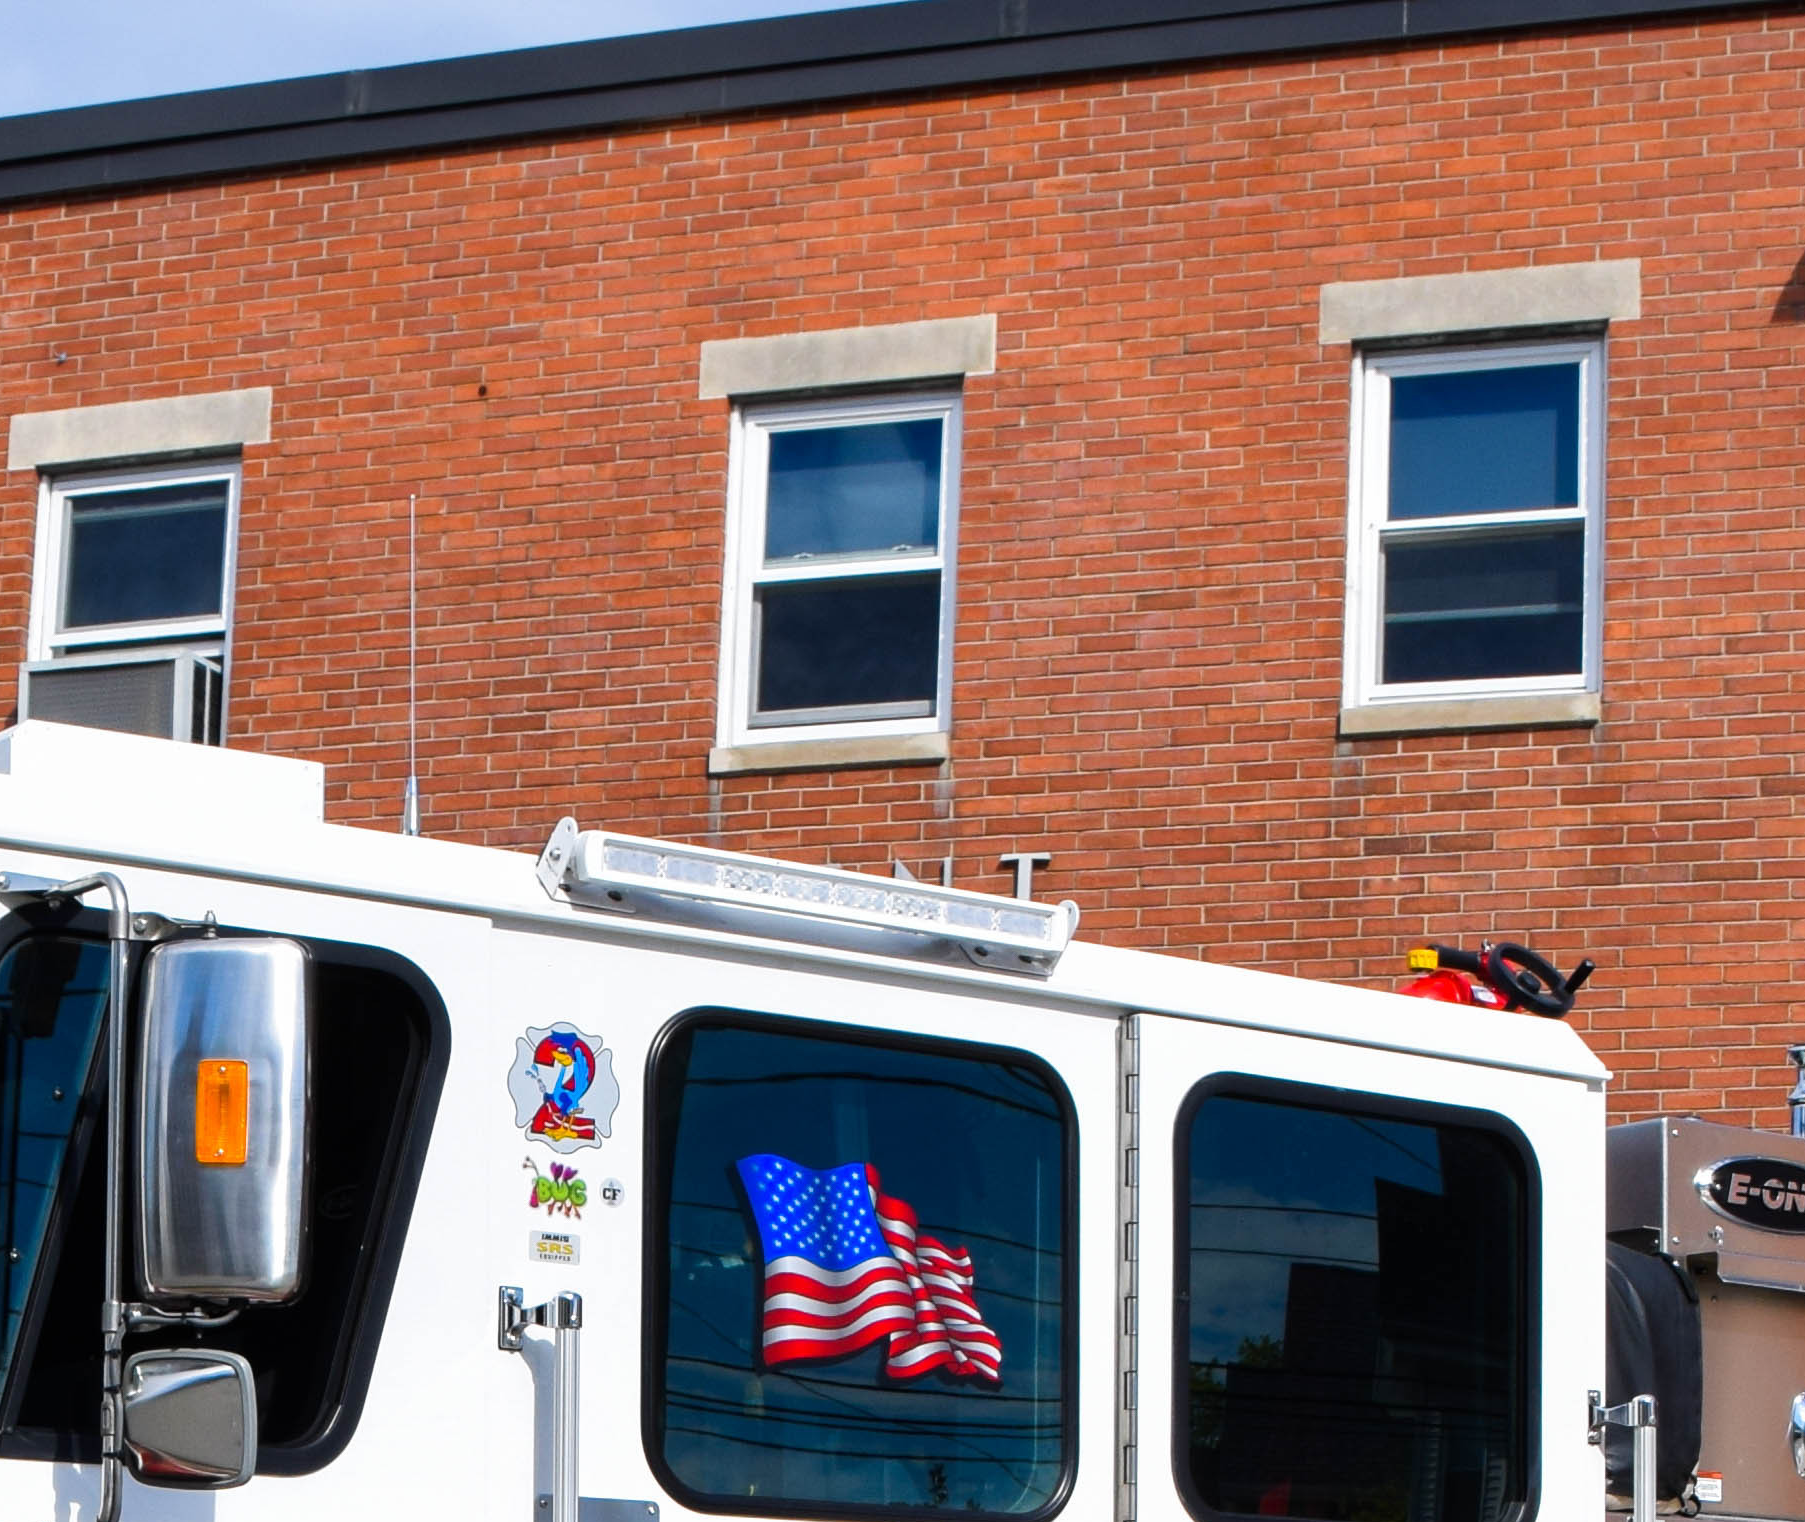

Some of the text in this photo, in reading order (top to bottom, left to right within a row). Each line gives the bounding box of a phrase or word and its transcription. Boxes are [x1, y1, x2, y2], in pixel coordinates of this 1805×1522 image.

[536, 1176, 587, 1207] BUG
[602, 1188, 621, 1200] CF
[536, 1242, 573, 1255] SRS
